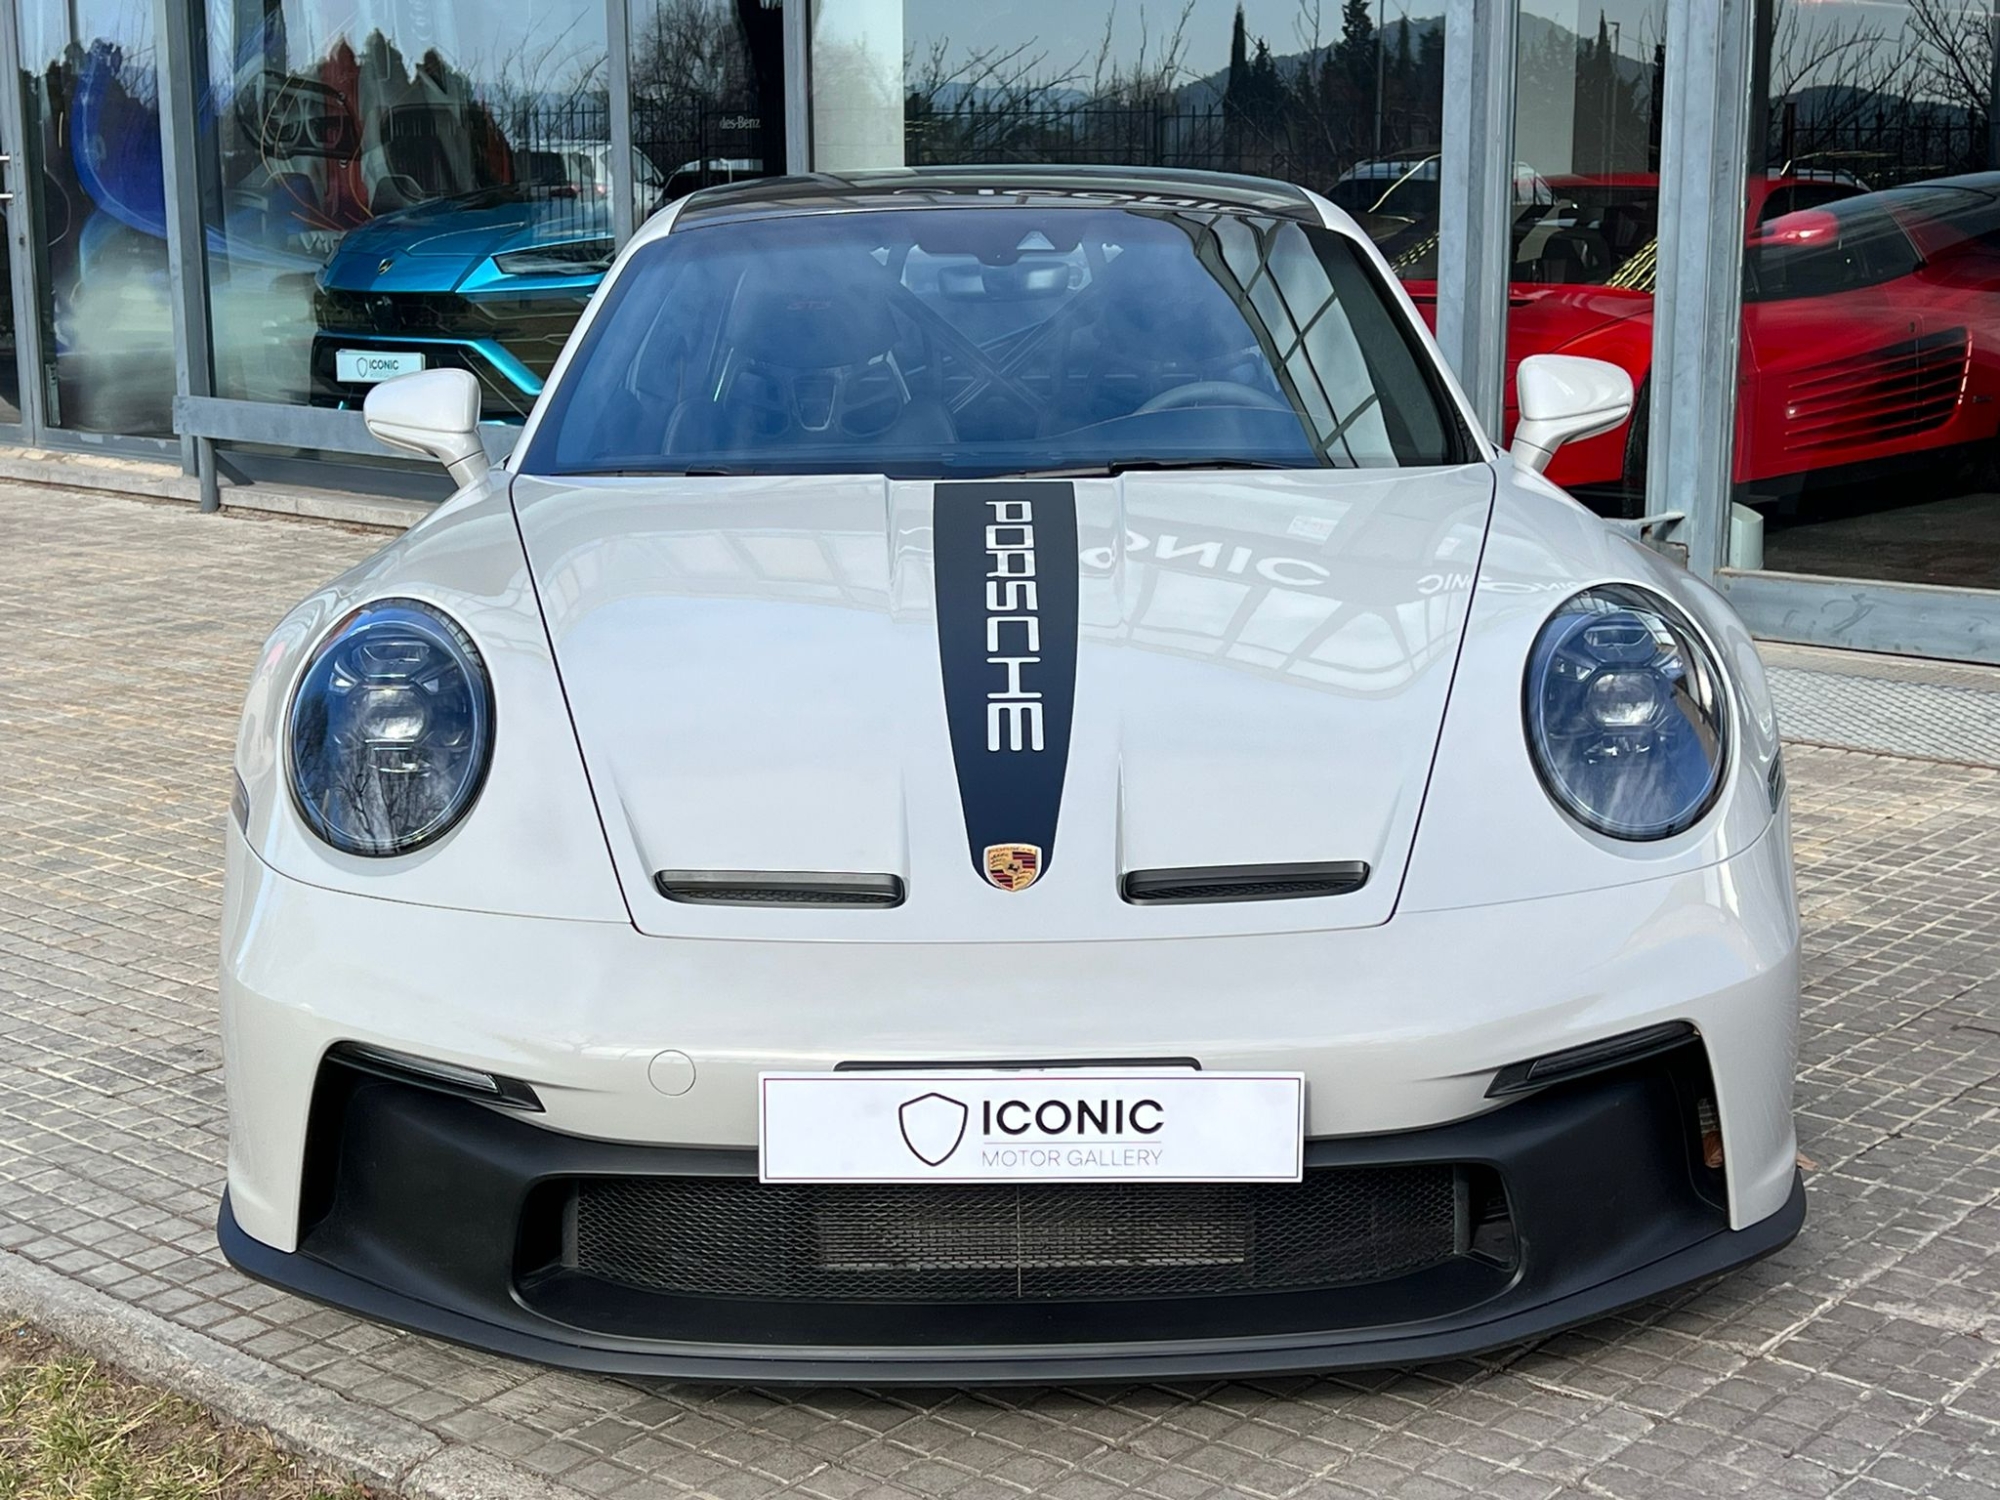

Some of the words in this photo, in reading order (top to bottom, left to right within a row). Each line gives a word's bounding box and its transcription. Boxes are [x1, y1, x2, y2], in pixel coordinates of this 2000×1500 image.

[368, 359, 399, 370] ICONIC
[985, 501, 1044, 752] PORSCHE
[983, 1099, 1164, 1135] ICONIC
[982, 1150, 1061, 1167] MOTOR
[1066, 1149, 1163, 1167] GALLERY
